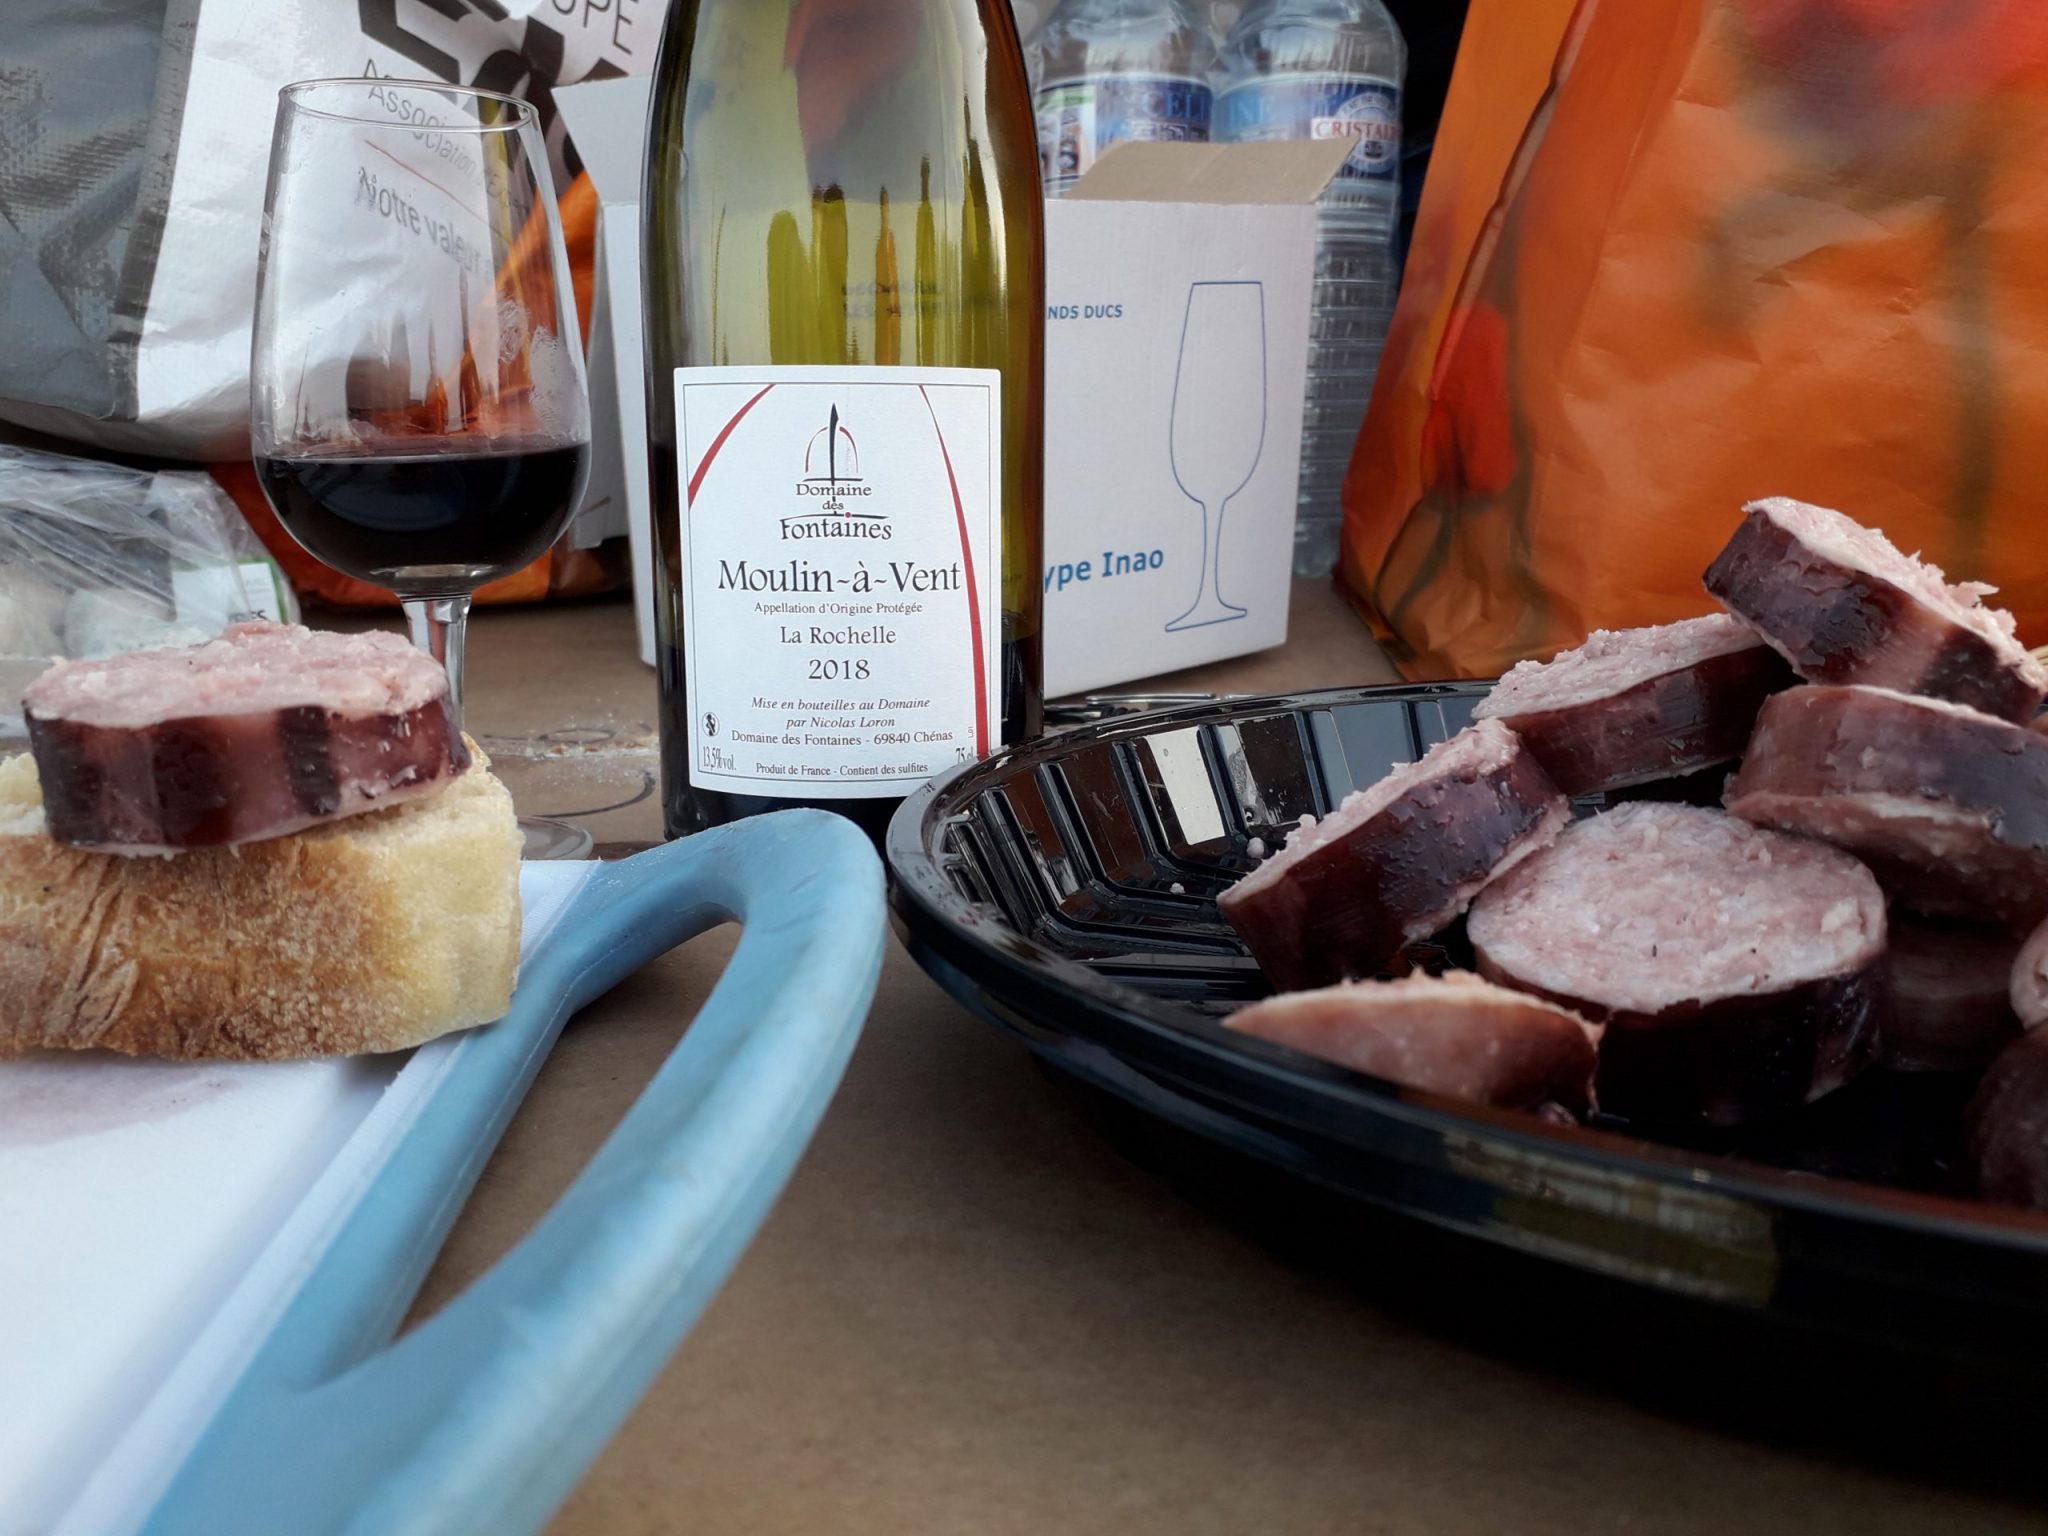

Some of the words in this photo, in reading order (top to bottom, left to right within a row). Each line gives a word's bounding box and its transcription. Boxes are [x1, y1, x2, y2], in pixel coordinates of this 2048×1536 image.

[1084, 305, 1123, 319] DUCS
[795, 483, 872, 497] Domaine
[822, 500, 844, 510] des
[779, 518, 893, 540] Fontaines
[1102, 549, 1164, 578] Inao
[754, 602, 815, 615] Appellation
[819, 602, 873, 616] d'Origine
[876, 602, 923, 615] Protégée
[780, 626, 802, 644] La
[809, 626, 897, 645] Rochelle
[808, 659, 871, 680] 2018
[752, 697, 778, 709] Mise
[780, 701, 794, 709] en
[798, 699, 855, 711] bouteilles
[859, 701, 874, 710] au
[878, 697, 931, 710] Domaine
[786, 718, 807, 730] par
[810, 717, 856, 728] Nicolas
[860, 716, 896, 728] Loron
[731, 730, 778, 744] Domaine
[781, 734, 800, 745] des
[804, 734, 862, 746] Fontaines
[873, 733, 911, 745] 69840
[913, 731, 953, 744] Chénas
[756, 762, 787, 775] Produit
[788, 765, 799, 775] de
[801, 764, 831, 776] France
[840, 764, 879, 776] Contient
[881, 764, 897, 774] des
[898, 761, 929, 773] sulfites
